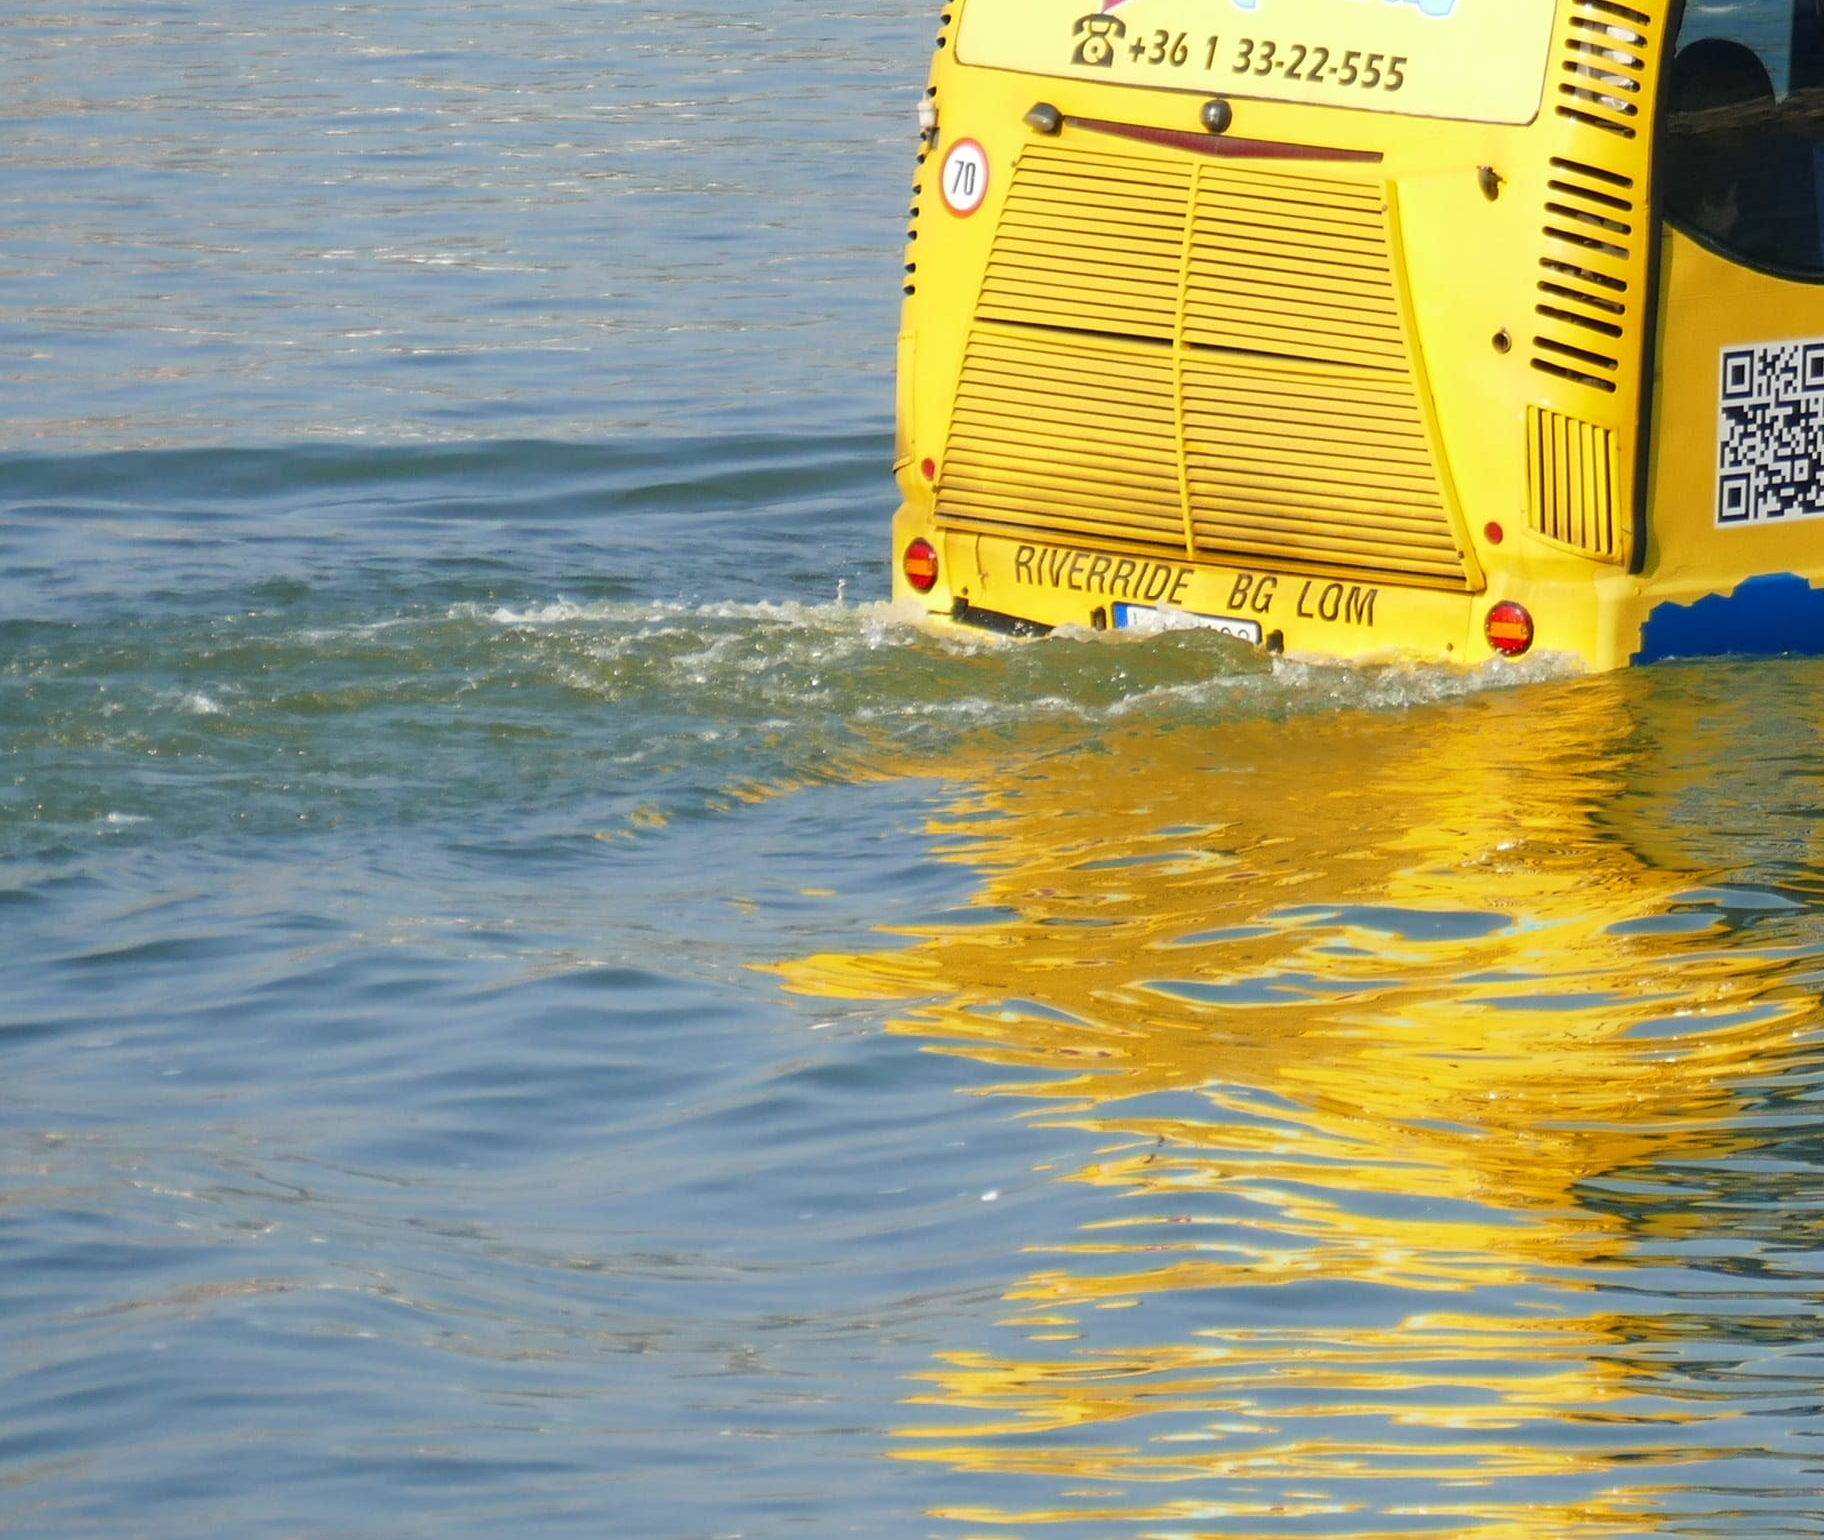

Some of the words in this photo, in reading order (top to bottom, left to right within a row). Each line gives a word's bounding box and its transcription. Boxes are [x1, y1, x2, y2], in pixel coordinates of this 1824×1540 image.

[1127, 29, 1189, 68] +36
[1203, 35, 1219, 71] 1
[1231, 37, 1408, 92] 33-22-555
[951, 160, 977, 197] 70
[1014, 544, 1195, 605] RIVERRIDE
[1226, 573, 1278, 614] BG
[1296, 580, 1379, 627] LOM
